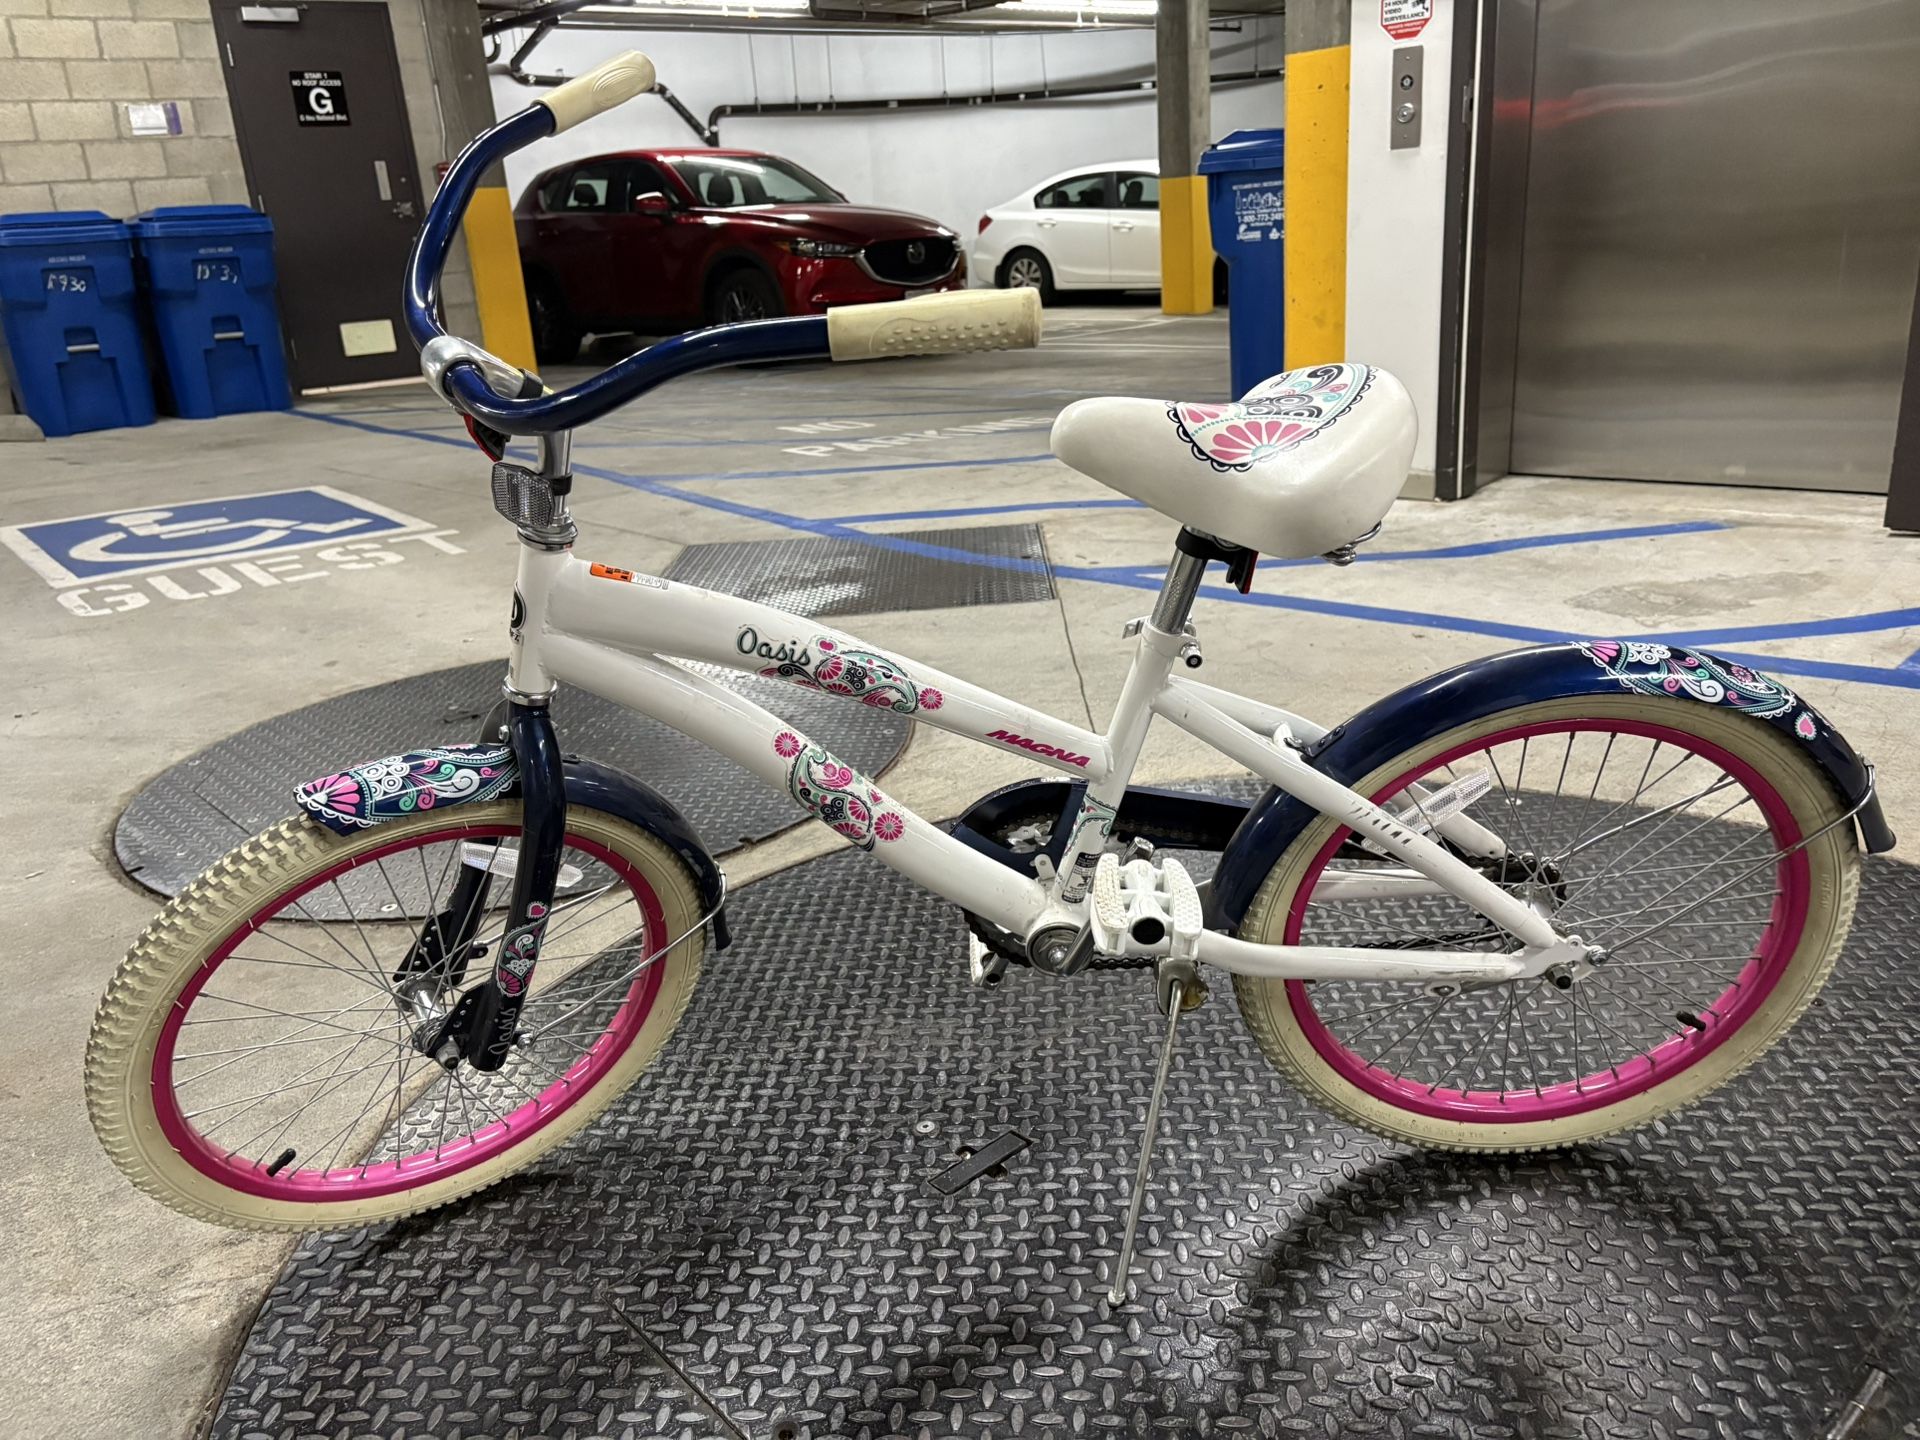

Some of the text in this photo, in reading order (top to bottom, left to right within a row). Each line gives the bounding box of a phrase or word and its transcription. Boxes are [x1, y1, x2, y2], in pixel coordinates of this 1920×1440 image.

[1384, 7, 1402, 15] VIDEO
[1384, 11, 1425, 22] SURVEILLANCE
[291, 79, 342, 87] NO ROOF ACCESS
[309, 87, 334, 114] G
[775, 420, 876, 434] NO
[781, 416, 1055, 457] PARKING
[56, 528, 467, 617] GUEST
[737, 627, 811, 666] Oasis
[984, 729, 1091, 767] MAGNA
